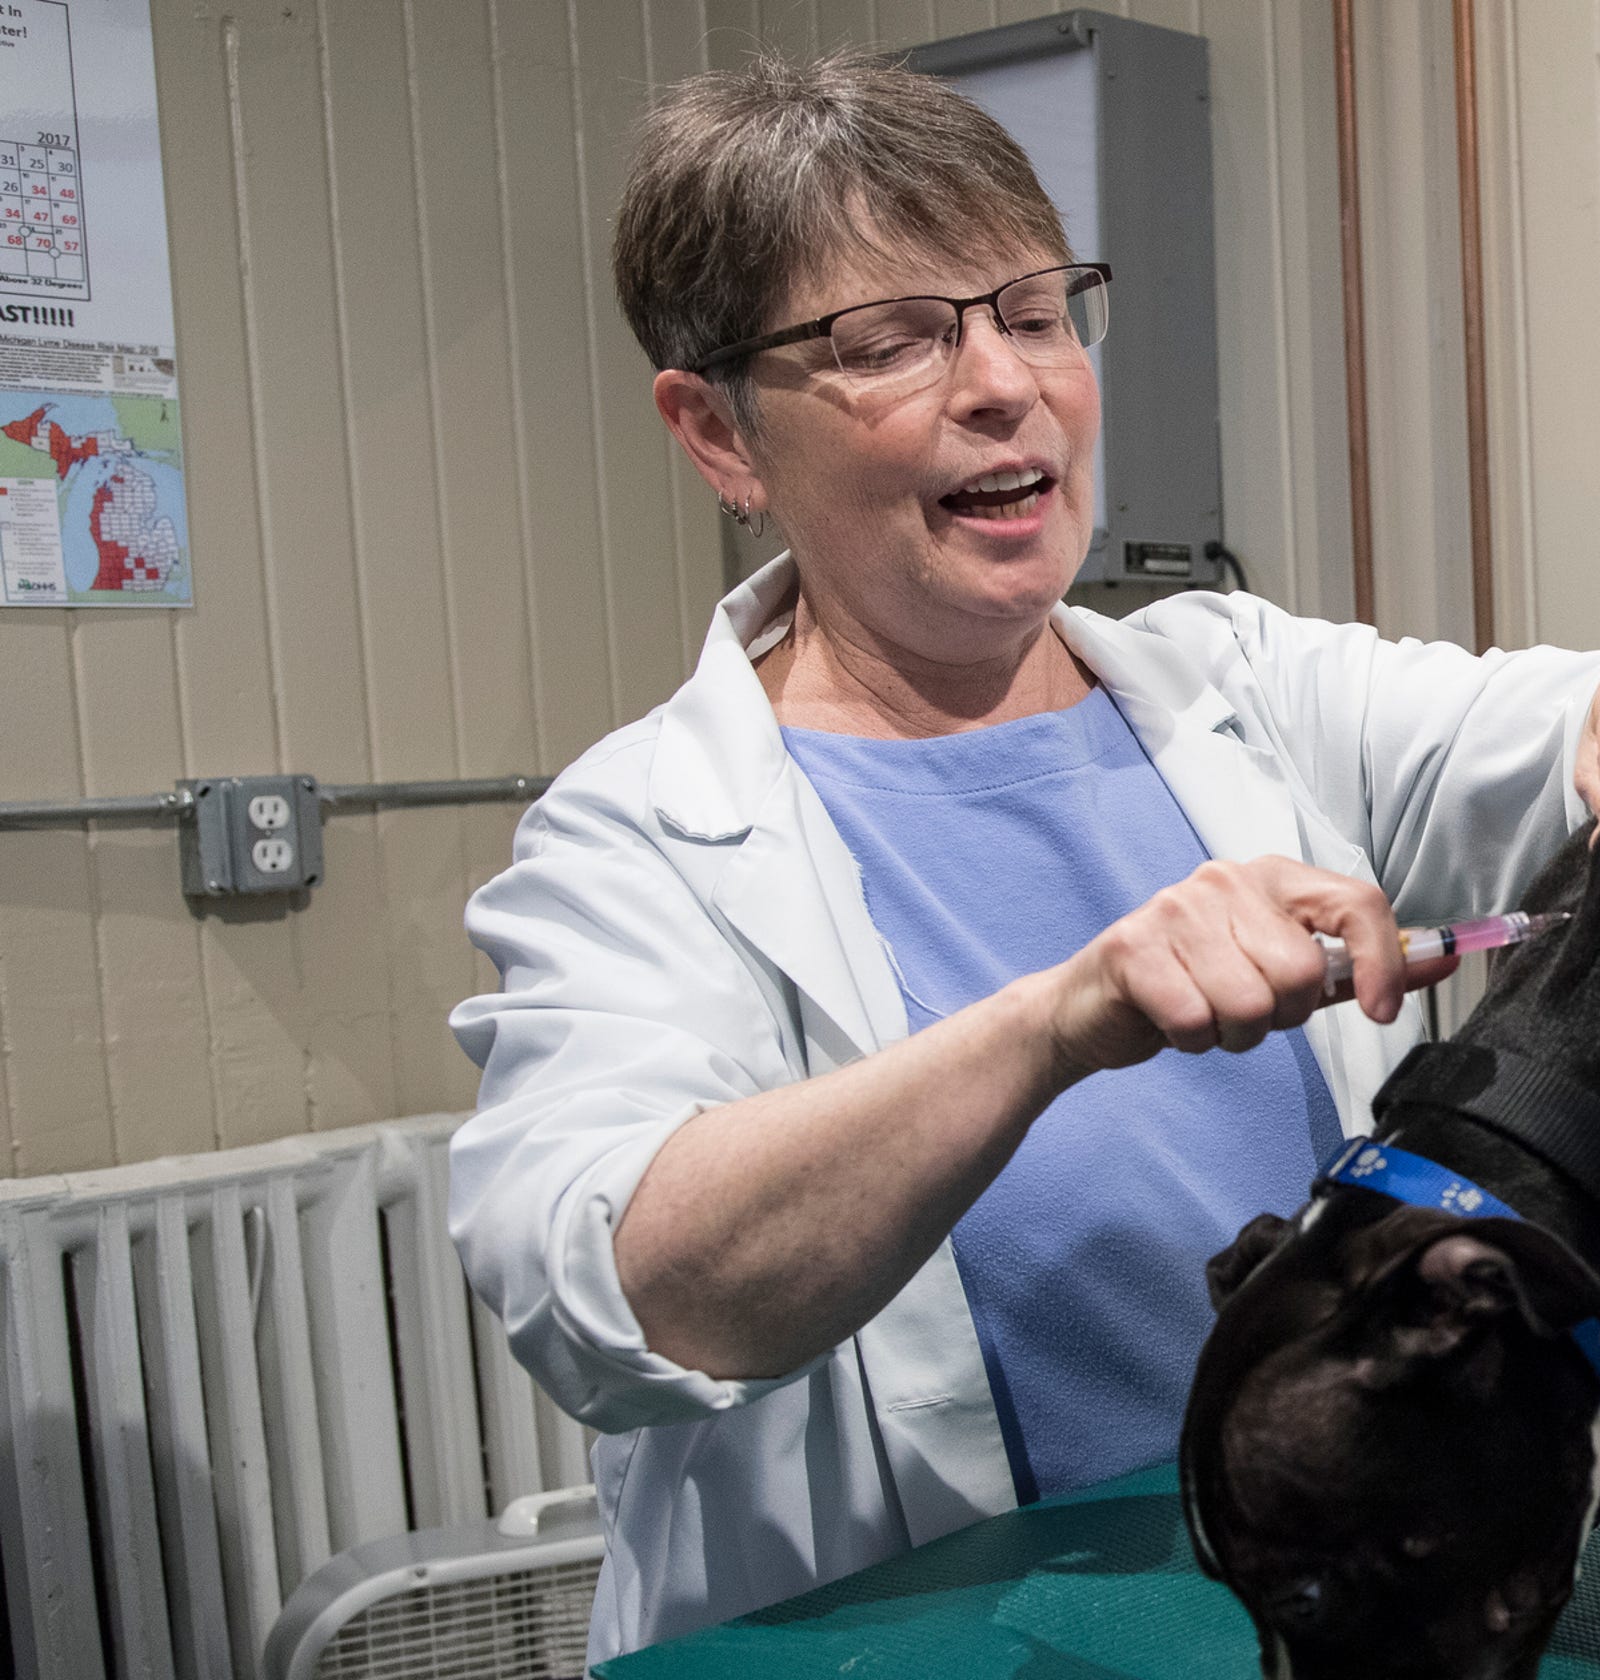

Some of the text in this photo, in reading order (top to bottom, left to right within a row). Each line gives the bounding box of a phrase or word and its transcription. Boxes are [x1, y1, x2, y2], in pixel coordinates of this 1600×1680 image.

[0, 25, 27, 38] ter!
[37, 131, 71, 146] 2017
[1, 154, 73, 173] 31 25 30
[3, 181, 75, 199] 26 34 48
[5, 208, 21, 219] 34
[33, 212, 49, 222] 47
[7, 235, 79, 251] 68 70 57
